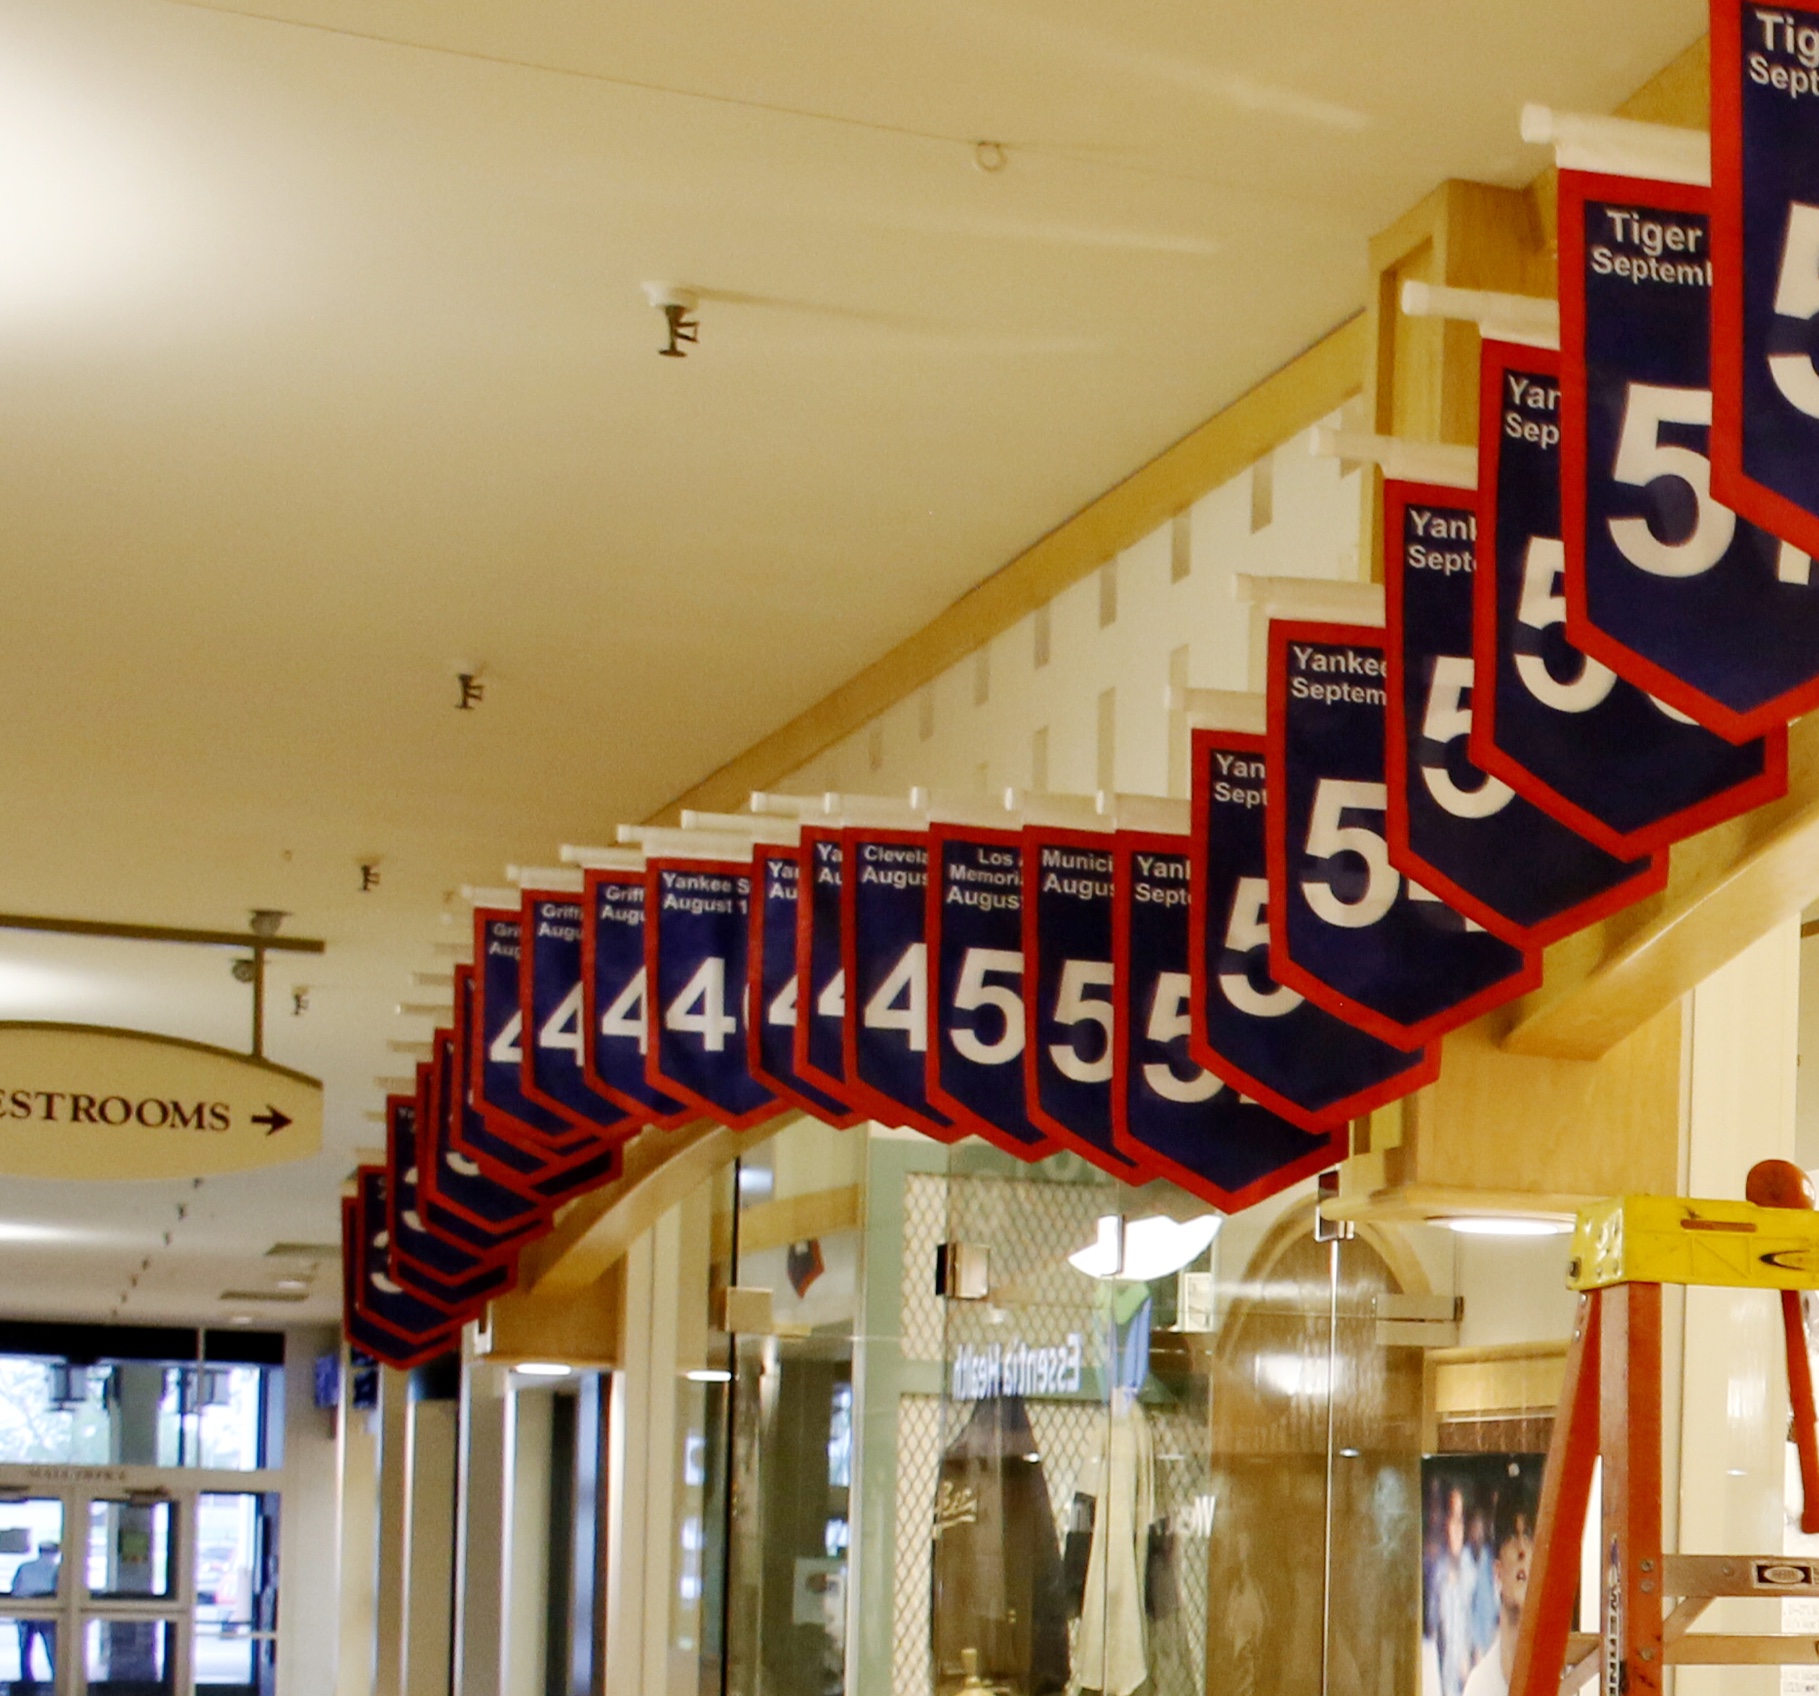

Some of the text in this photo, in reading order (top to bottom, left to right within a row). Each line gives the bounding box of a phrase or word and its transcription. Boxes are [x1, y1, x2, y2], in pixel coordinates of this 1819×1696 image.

[1605, 209, 1702, 256] Tiger
[1592, 247, 1713, 286] Septem
[1505, 412, 1560, 449] Sep
[1408, 508, 1477, 542] Yan
[1408, 545, 1477, 576] Sept
[978, 849, 1013, 866] Los
[1138, 856, 1191, 881] Yan
[662, 871, 732, 892] Yankee
[947, 886, 1023, 912] Augus
[1135, 883, 1191, 908] Sept
[663, 893, 732, 915] August
[666, 956, 749, 1052] 4
[864, 942, 928, 1052] 4
[950, 947, 1026, 1065] 5
[1049, 959, 1113, 1082] 5
[0, 1090, 231, 1132] STROOMS
